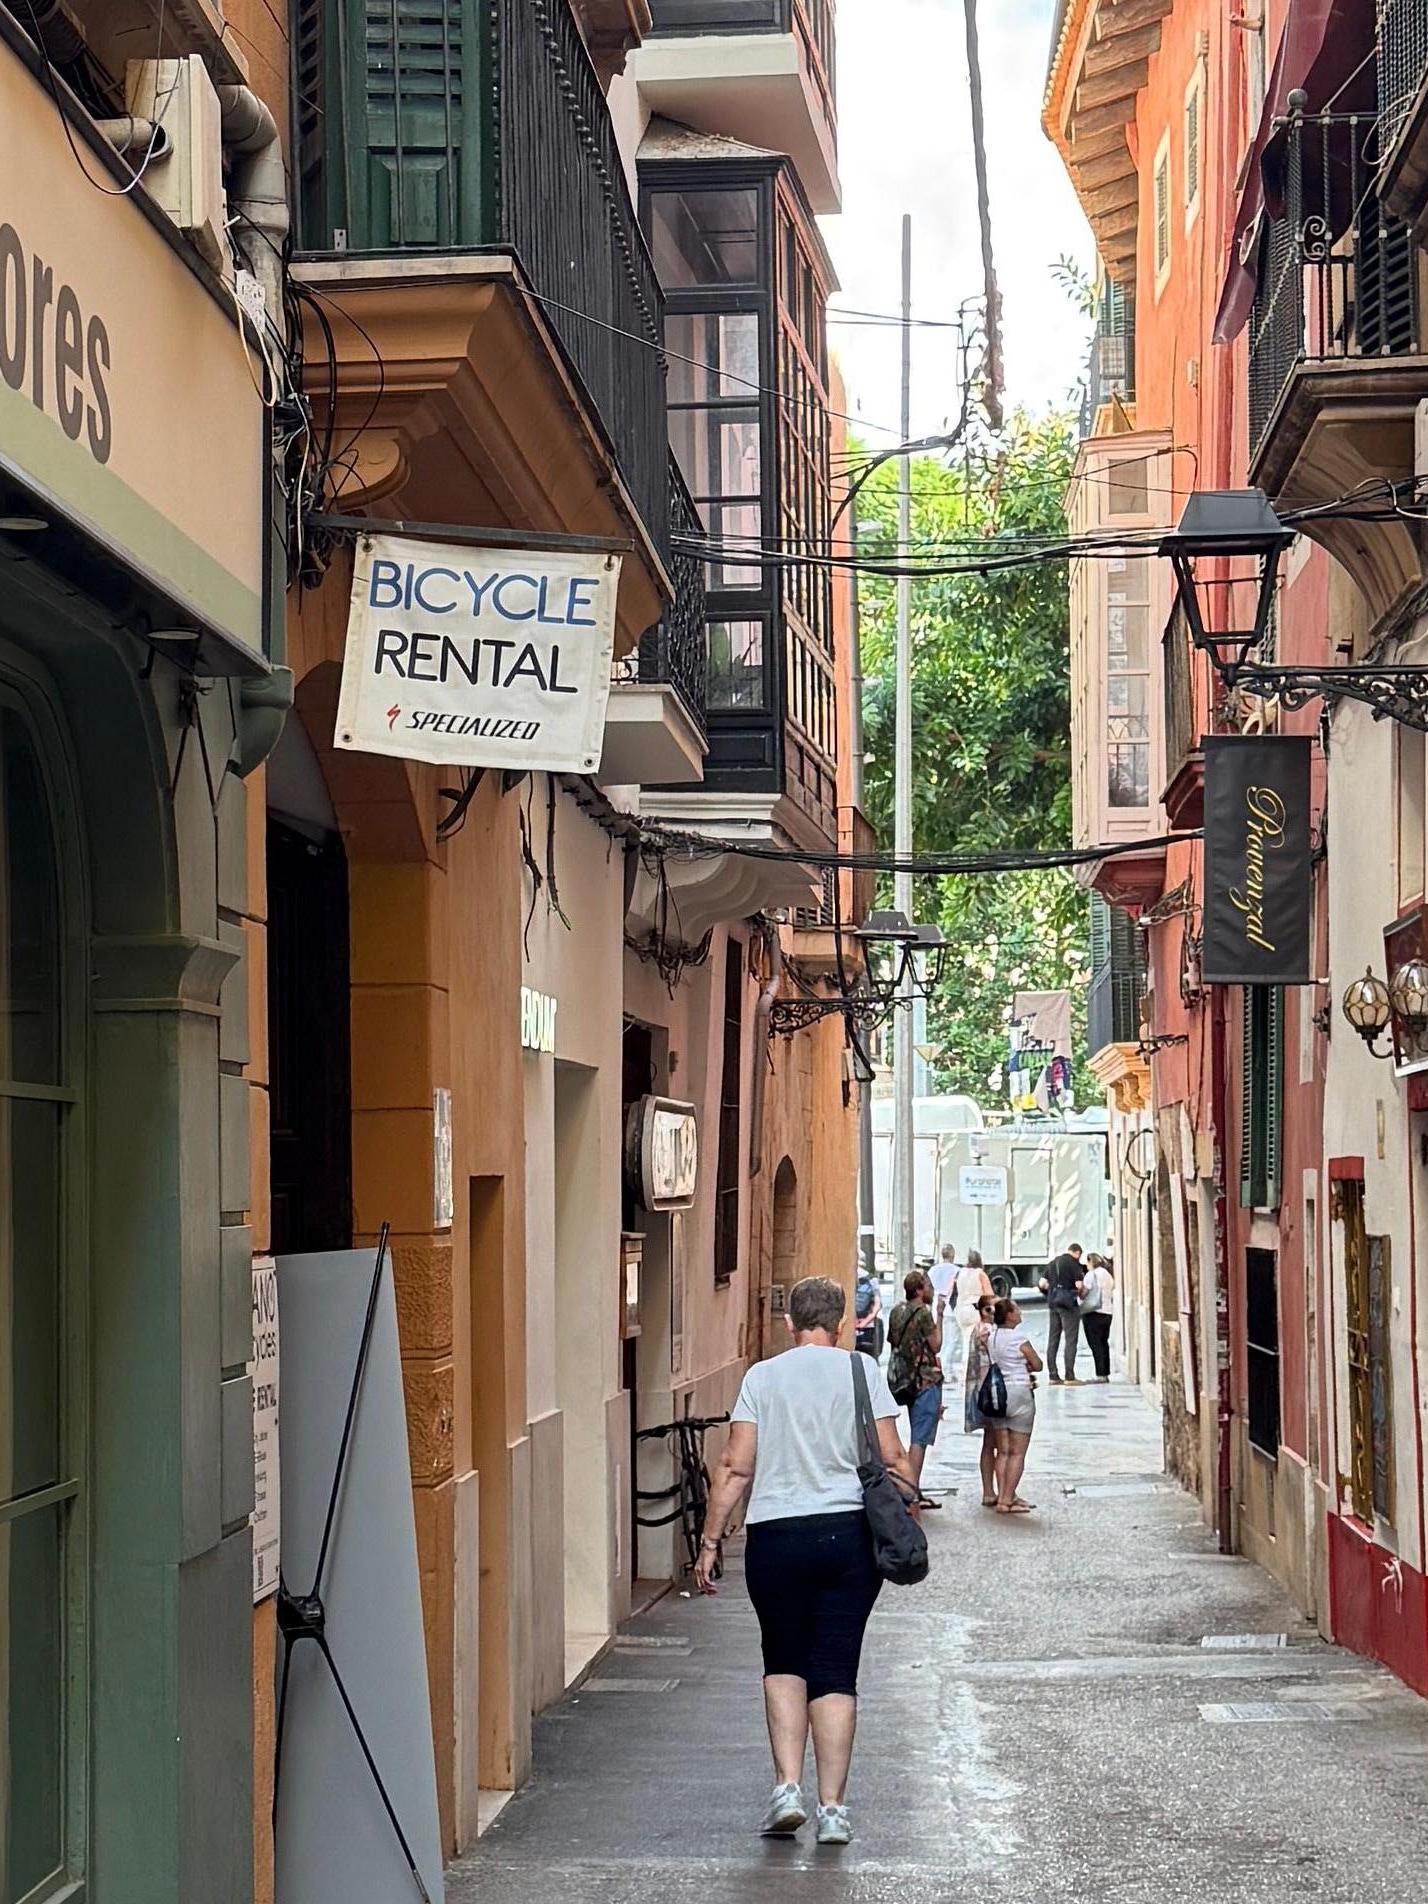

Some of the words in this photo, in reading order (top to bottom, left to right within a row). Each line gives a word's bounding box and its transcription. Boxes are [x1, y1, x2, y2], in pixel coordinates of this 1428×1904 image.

[368, 559, 601, 627] BICYCLE
[373, 629, 578, 694] RENTAL
[405, 710, 541, 741] SPECIALIZED
[1228, 785, 1287, 952] Provenzal
